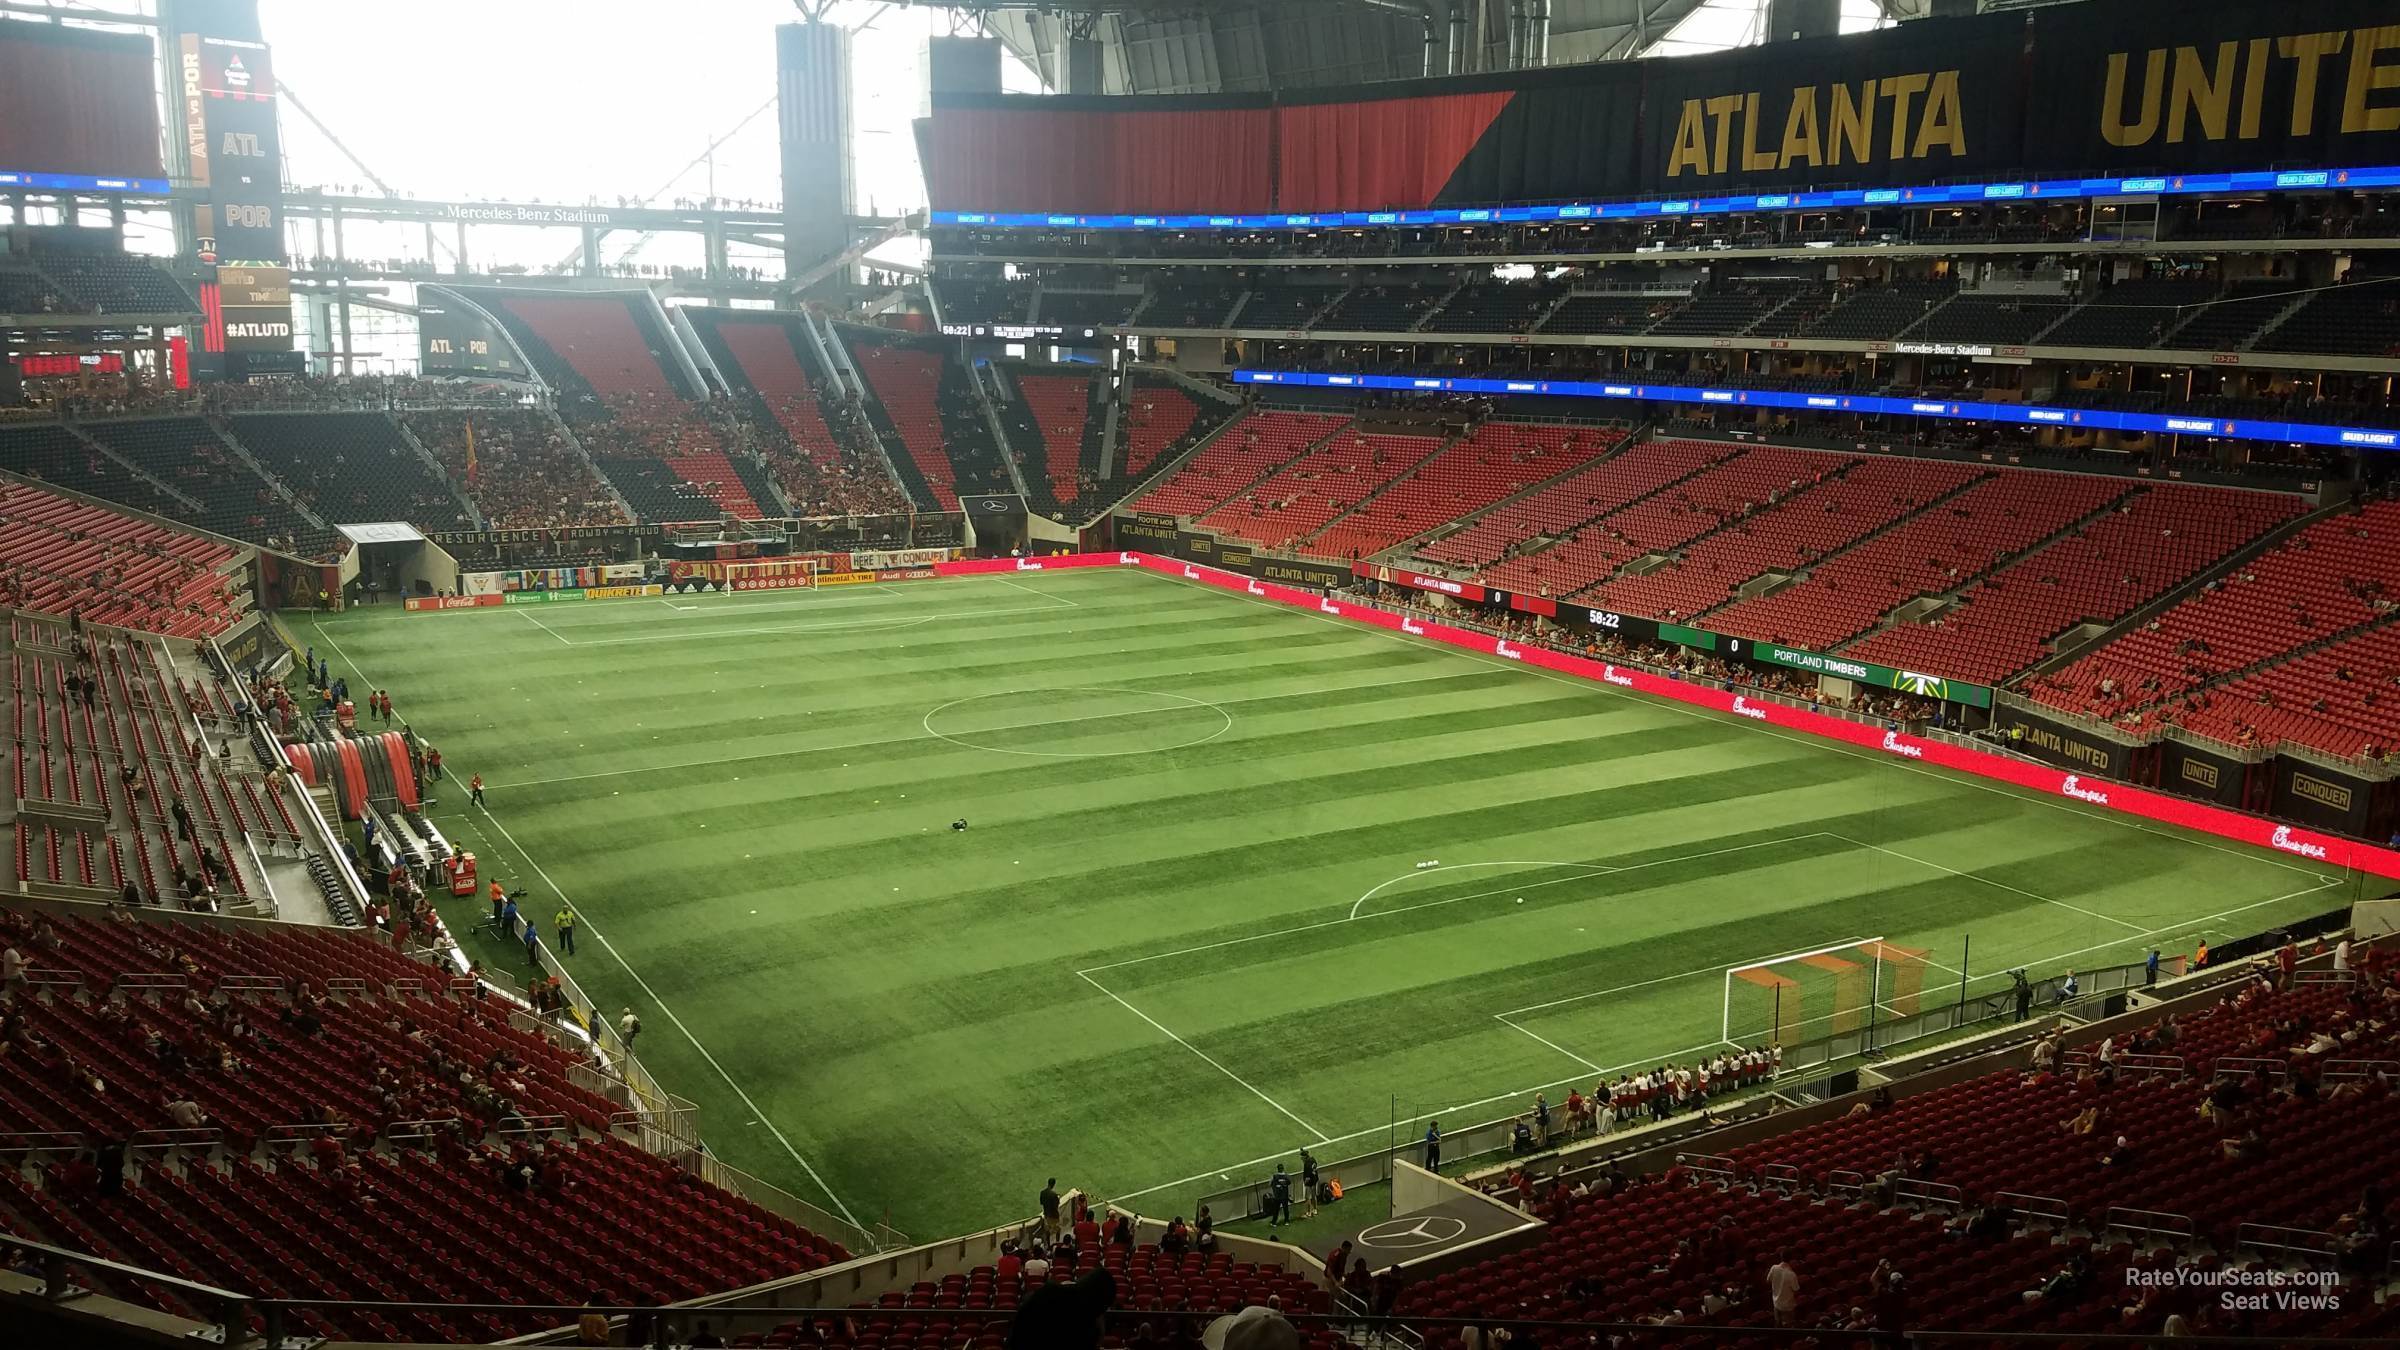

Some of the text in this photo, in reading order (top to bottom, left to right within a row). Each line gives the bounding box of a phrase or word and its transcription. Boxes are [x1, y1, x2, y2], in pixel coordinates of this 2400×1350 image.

[183, 53, 201, 97] POR
[1666, 24, 2400, 177] ATLANTA UNITE
[188, 117, 207, 158] ATL
[222, 132, 266, 157] ATL
[2123, 181, 2163, 190] BUD LIGHT
[2279, 174, 2325, 184] BUD LIGHT
[2002, 187, 2022, 195] LIGHT
[225, 204, 272, 228] POR
[447, 205, 609, 223] Mercedes-Benz Stadium
[226, 323, 289, 337] #ATLUTD
[430, 339, 488, 355] ATL POR
[1895, 342, 1955, 354] Mercedes-Benz
[1956, 344, 1992, 356] Stadium
[2045, 412, 2064, 420] LIGHT
[2168, 420, 2212, 430] BUD LIGHT
[2343, 431, 2395, 443] BUD LIGHT
[2302, 482, 2315, 490] 112C
[1138, 516, 1159, 525] FOOTIE
[434, 531, 540, 544] RESURGENCE
[571, 529, 609, 538] ROWDY
[628, 526, 659, 536] PROUD
[1121, 524, 1154, 537] ATLANTA
[1192, 541, 1209, 551] UNITE
[853, 554, 874, 566] HERE
[902, 551, 945, 563] CONQUER
[1223, 553, 1251, 564] CONQUER
[1264, 566, 1338, 586] ATLANTA UNITED
[1413, 576, 1462, 594] ATLANTA UNITED
[586, 588, 643, 600] QUIKRETE
[1494, 591, 1501, 603] 0
[1589, 609, 1619, 628] 58:22
[1730, 639, 1739, 652] 0
[1774, 649, 1867, 678] PORTLAND TIMBERS
[2064, 738, 2109, 769] UNITED
[2186, 762, 2215, 784] UNITE
[2295, 778, 2348, 806] CONQUER
[2272, 826, 2326, 859] Chick-fil-A
